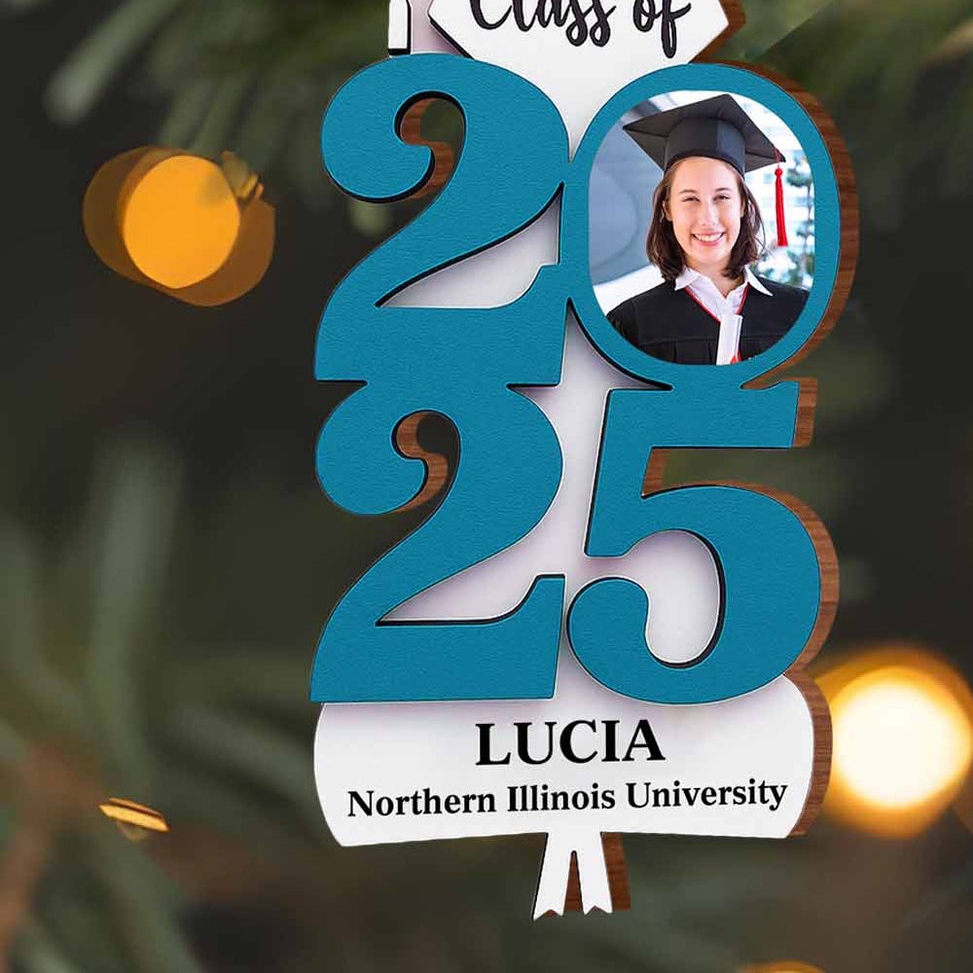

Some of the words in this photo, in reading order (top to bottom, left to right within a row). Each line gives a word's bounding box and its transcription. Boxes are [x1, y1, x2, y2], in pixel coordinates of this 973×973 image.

[476, 720, 665, 765] LUCIA
[348, 788, 496, 817] Northern
[508, 783, 615, 811] Illinois
[626, 778, 788, 811] University
